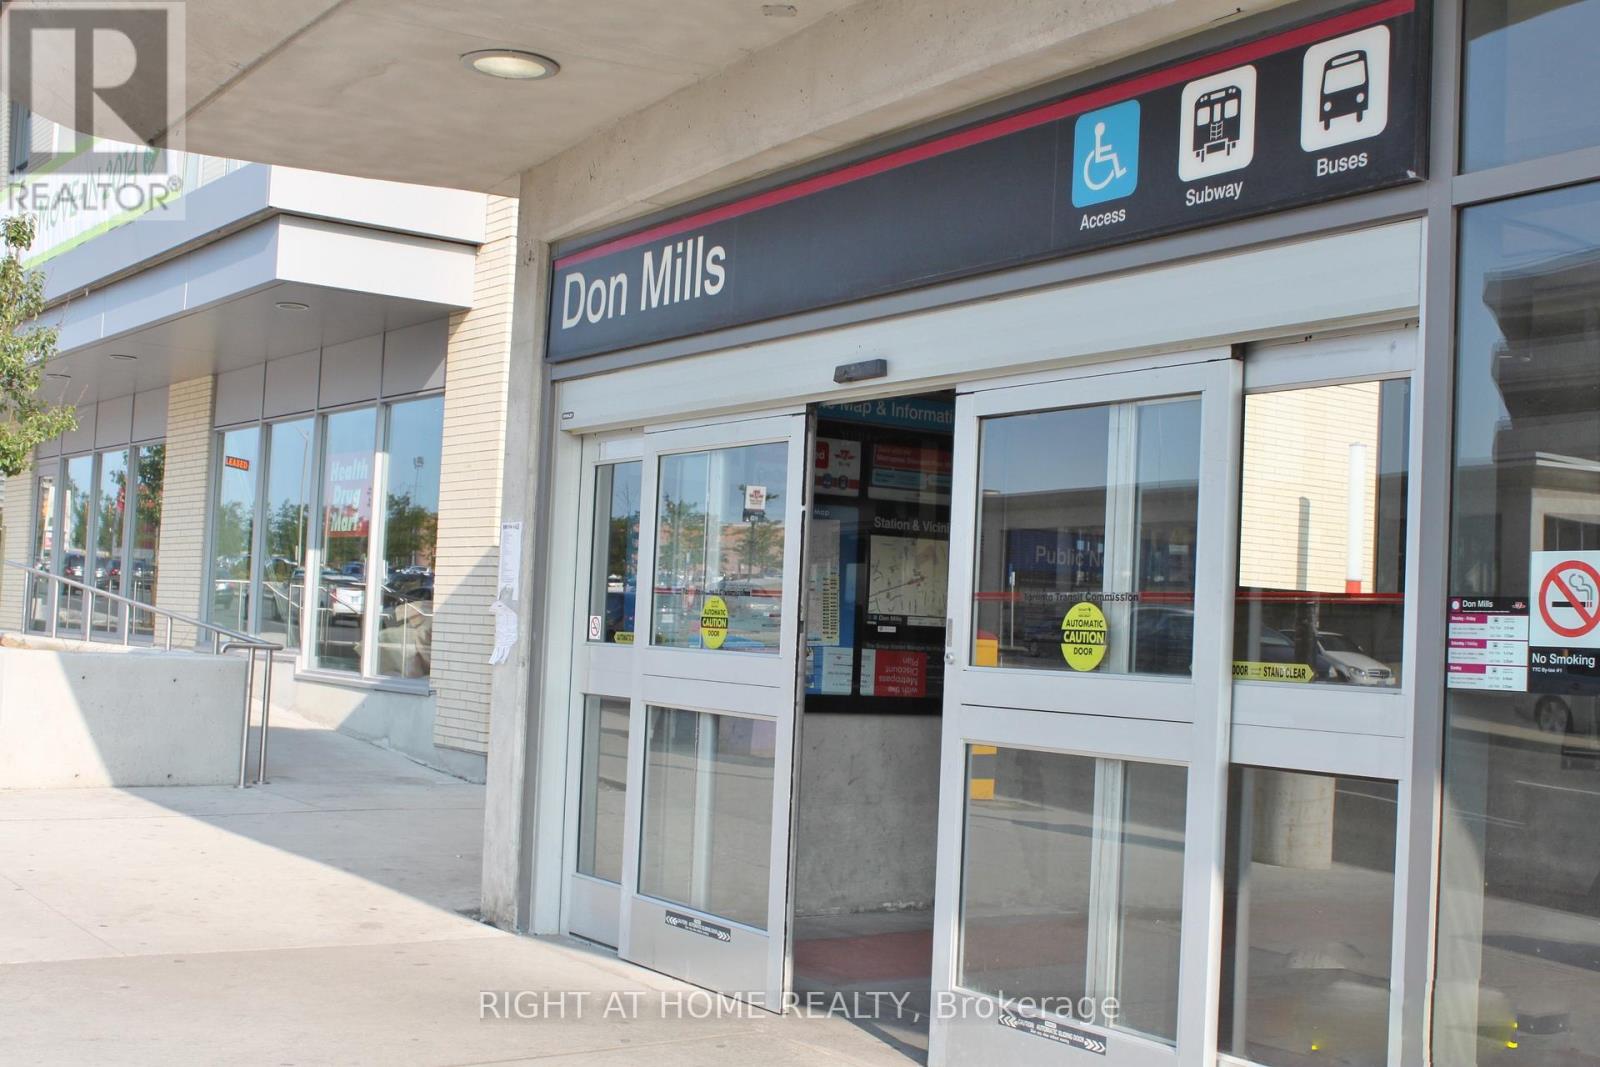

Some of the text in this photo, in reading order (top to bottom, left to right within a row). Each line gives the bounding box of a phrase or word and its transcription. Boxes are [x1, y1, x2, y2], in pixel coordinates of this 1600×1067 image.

[1316, 152, 1369, 177] Buses
[1185, 180, 1244, 207] Subway
[1079, 208, 1126, 231] Access
[562, 235, 726, 330] Don Mills
[876, 401, 887, 416] &
[226, 457, 249, 471] LEASED
[331, 458, 368, 481] Health
[333, 485, 361, 508] Drug
[330, 510, 360, 531] Mart
[874, 516, 911, 531] Station
[912, 520, 920, 532] &
[1036, 544, 1084, 566] Public
[1056, 592, 1084, 601] Transit
[1086, 592, 1140, 601] Commission
[1462, 600, 1493, 608] Don Mills
[702, 617, 727, 628] CAUTION
[1066, 619, 1103, 628] AUTOMATIC
[1063, 631, 1105, 644] CAUTION
[1073, 647, 1093, 656] DOOR
[1532, 653, 1596, 668] No Smoking
[1263, 666, 1285, 678] STAND
[1285, 668, 1306, 679] CLEAR
